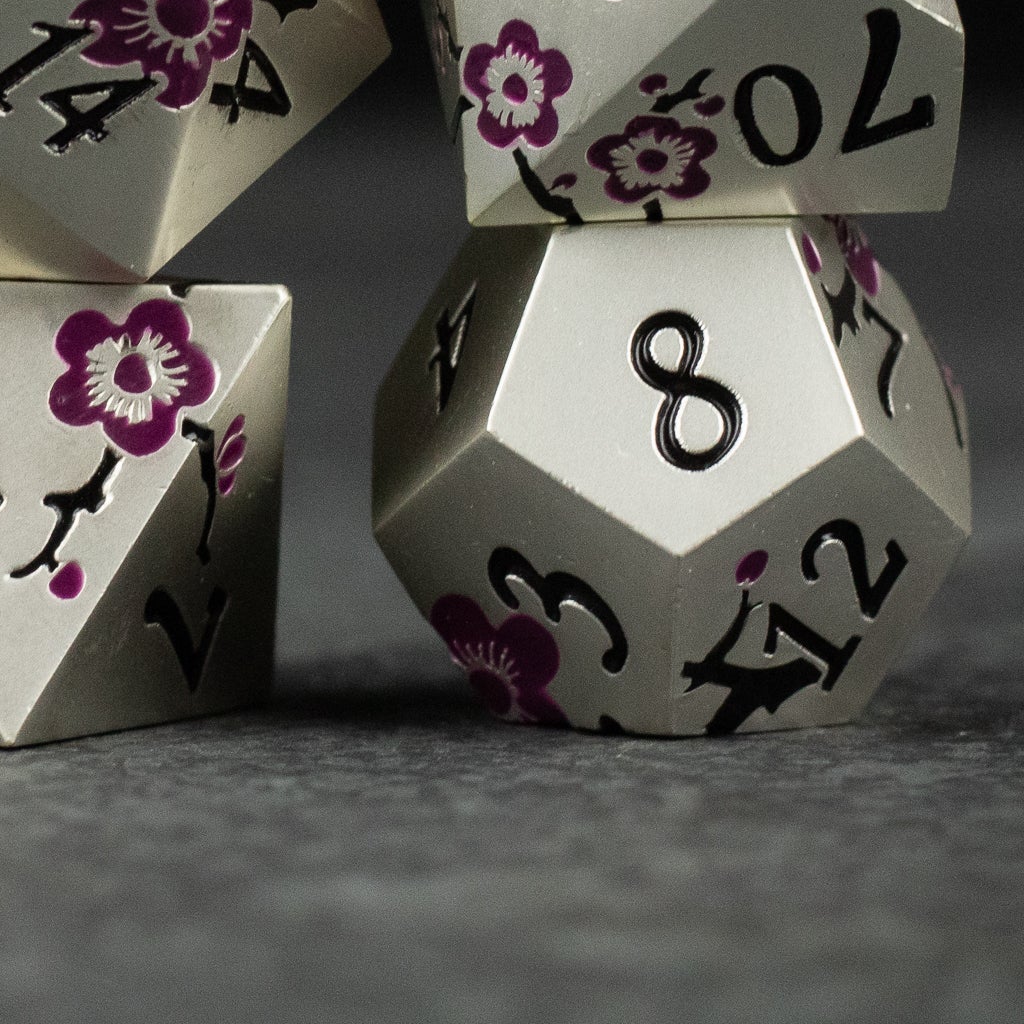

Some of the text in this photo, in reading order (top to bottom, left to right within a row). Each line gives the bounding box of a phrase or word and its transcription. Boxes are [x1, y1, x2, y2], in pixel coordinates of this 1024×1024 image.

[208, 36, 293, 125] 4
[733, 6, 940, 171] 70
[629, 308, 747, 473] 8
[486, 546, 630, 676] 3
[762, 517, 910, 693] 12
